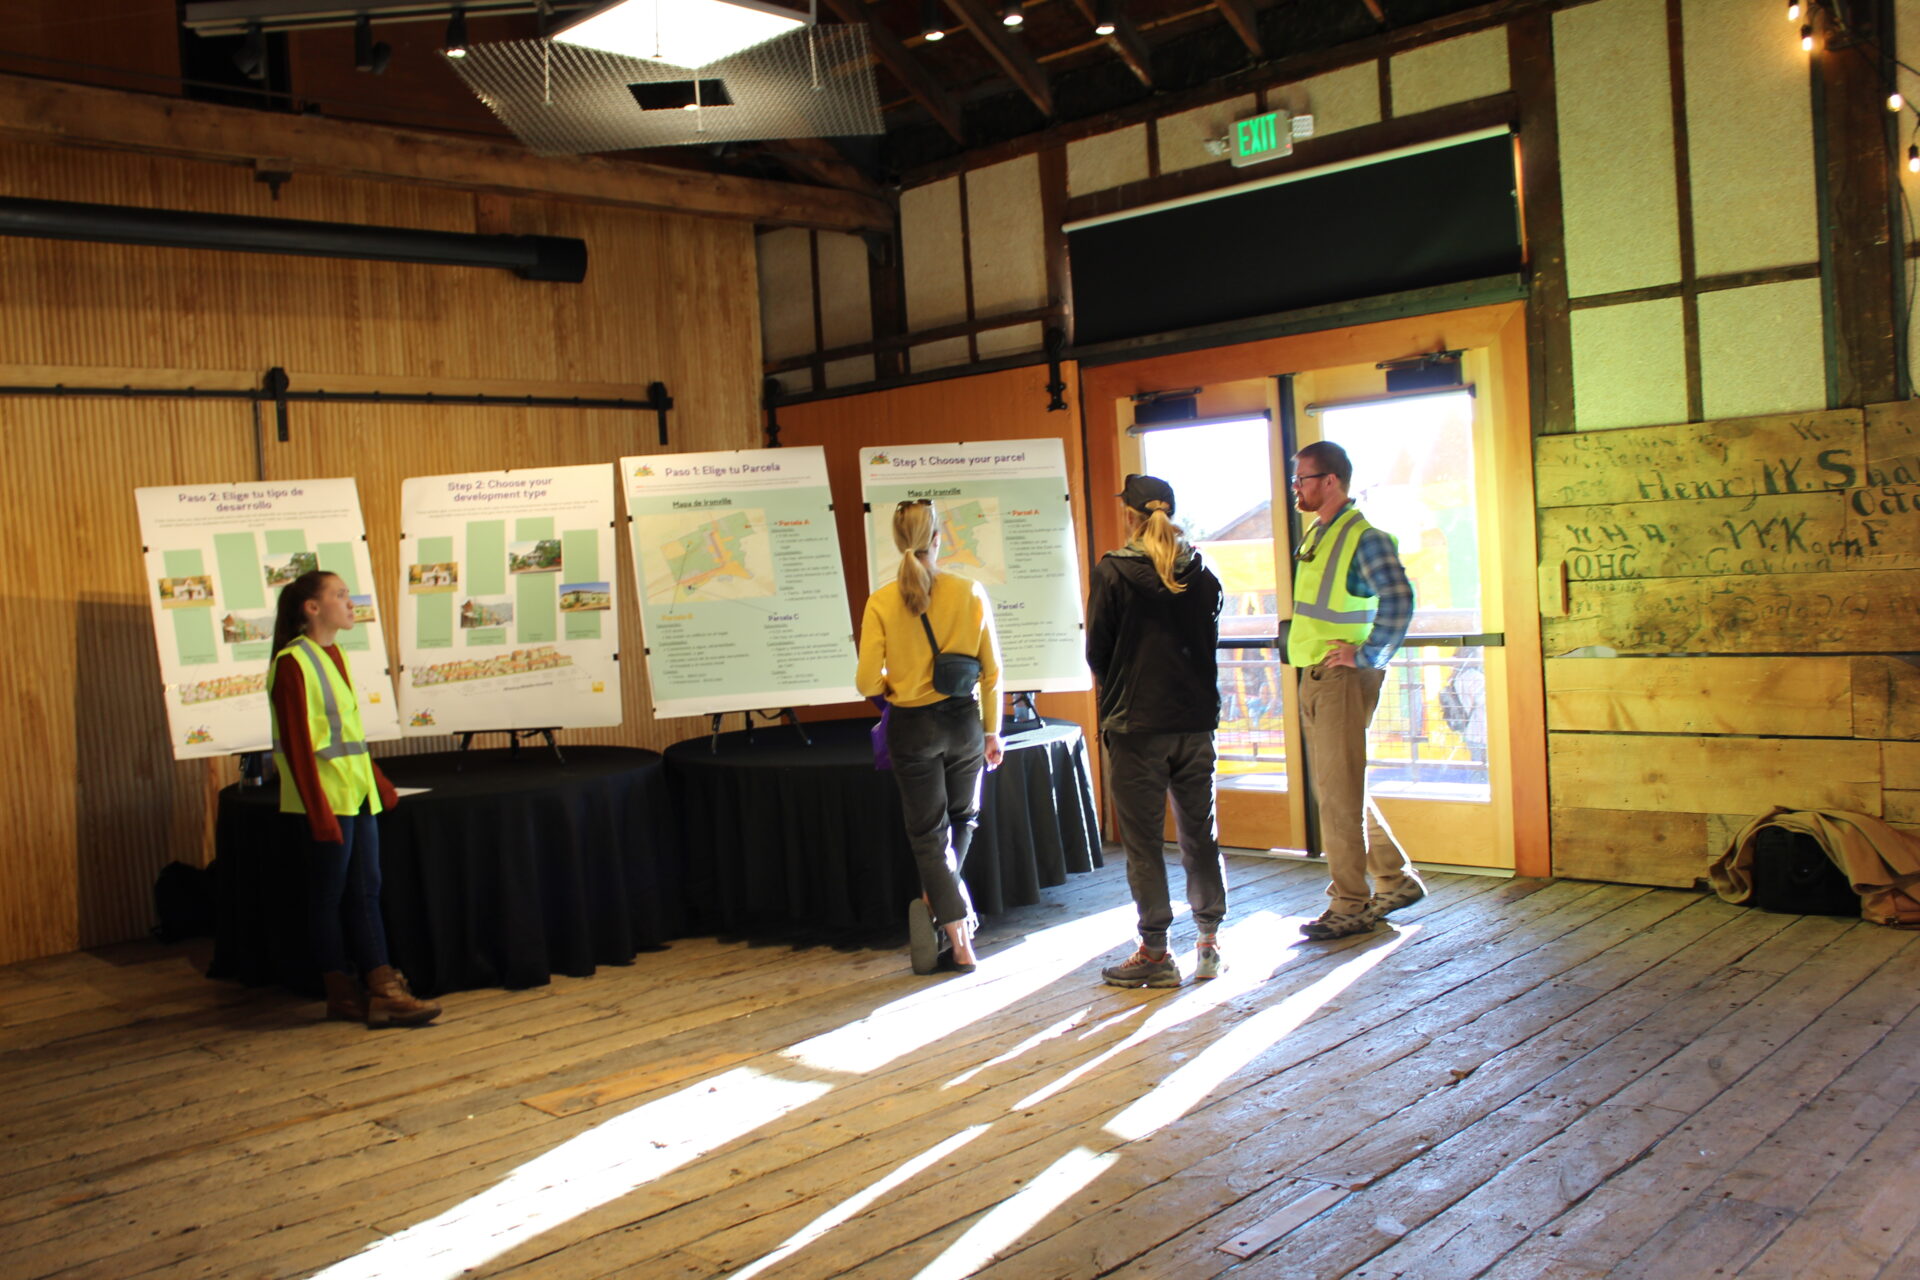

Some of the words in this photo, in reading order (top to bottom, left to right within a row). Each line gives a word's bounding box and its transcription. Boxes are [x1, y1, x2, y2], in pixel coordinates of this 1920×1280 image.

[1237, 113, 1277, 157] EXIT
[893, 457, 917, 468] Step
[919, 456, 927, 465] 1:
[928, 455, 966, 466] Choose
[969, 455, 991, 466] your
[994, 453, 1025, 464] parcel
[665, 467, 691, 477] Paso
[693, 467, 701, 475] 1:
[702, 465, 727, 477] Elige
[729, 464, 740, 475] tu
[742, 462, 781, 473] Parcela
[448, 481, 472, 492] Step
[475, 480, 486, 489] 2:
[487, 479, 526, 489] Choose
[529, 477, 553, 488] your
[178, 493, 206, 503] Paso
[209, 491, 220, 501] 2:
[222, 489, 249, 502] Elige
[252, 490, 264, 499] tu
[267, 488, 288, 499] tipo
[290, 487, 304, 497] de
[453, 490, 520, 502] development
[523, 489, 547, 499] type
[216, 501, 272, 512] desarrollo
